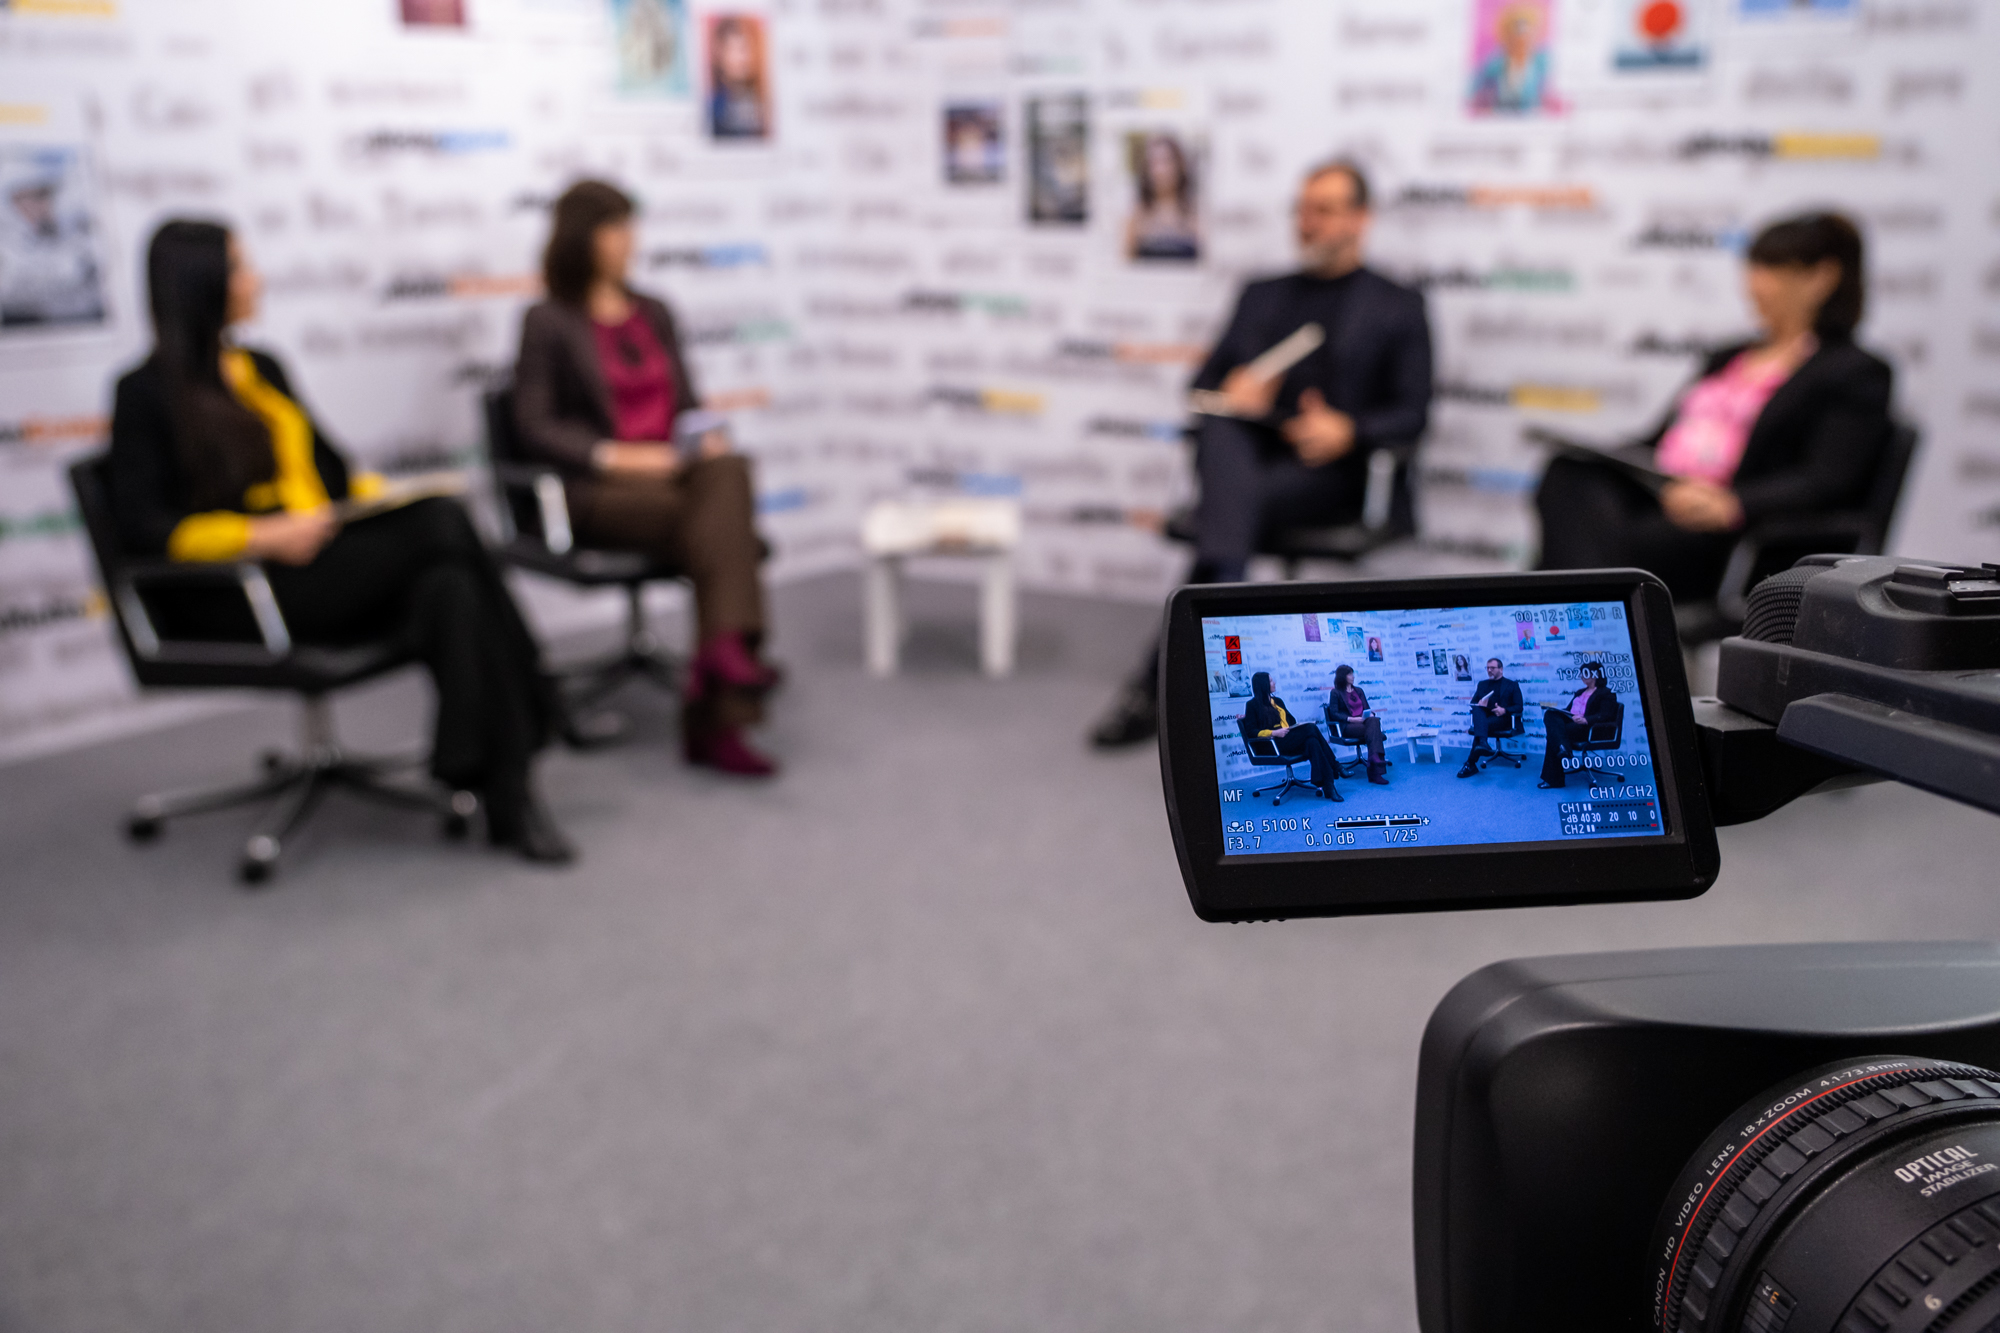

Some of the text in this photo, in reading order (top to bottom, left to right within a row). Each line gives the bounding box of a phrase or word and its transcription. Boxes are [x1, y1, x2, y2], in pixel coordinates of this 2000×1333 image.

[1573, 651, 1630, 665] 50 Mbps
[1558, 666, 1632, 680] 1920x1080
[1610, 681, 1635, 693] 25P
[1223, 789, 1243, 802] MF
[1590, 785, 1653, 799] CH1/CH2
[1561, 803, 1580, 813] CH1
[1609, 812, 1619, 821] 20
[1628, 811, 1637, 820] 10
[1650, 810, 1656, 820] 0
[1262, 819, 1297, 832] 5100
[1302, 818, 1311, 830] K
[1565, 824, 1585, 834] CH2
[1306, 833, 1332, 846] 0.0
[1337, 832, 1355, 844] dB
[1383, 829, 1418, 842] 1/25
[1894, 1145, 1979, 1183] OPTICAL
[1922, 1160, 1975, 1184] IMAGE
[1920, 1163, 1999, 1197] STABILIZER
[1653, 1268, 1667, 1326] CANON
[1664, 1236, 1675, 1260] HD
[1675, 1182, 1703, 1227] VIDEO
[1706, 1143, 1735, 1176] LENS
[1820, 1061, 1908, 1087] 4.1-73.8mm
[1762, 1284, 1773, 1296] ft
[1769, 1291, 1780, 1304] m
